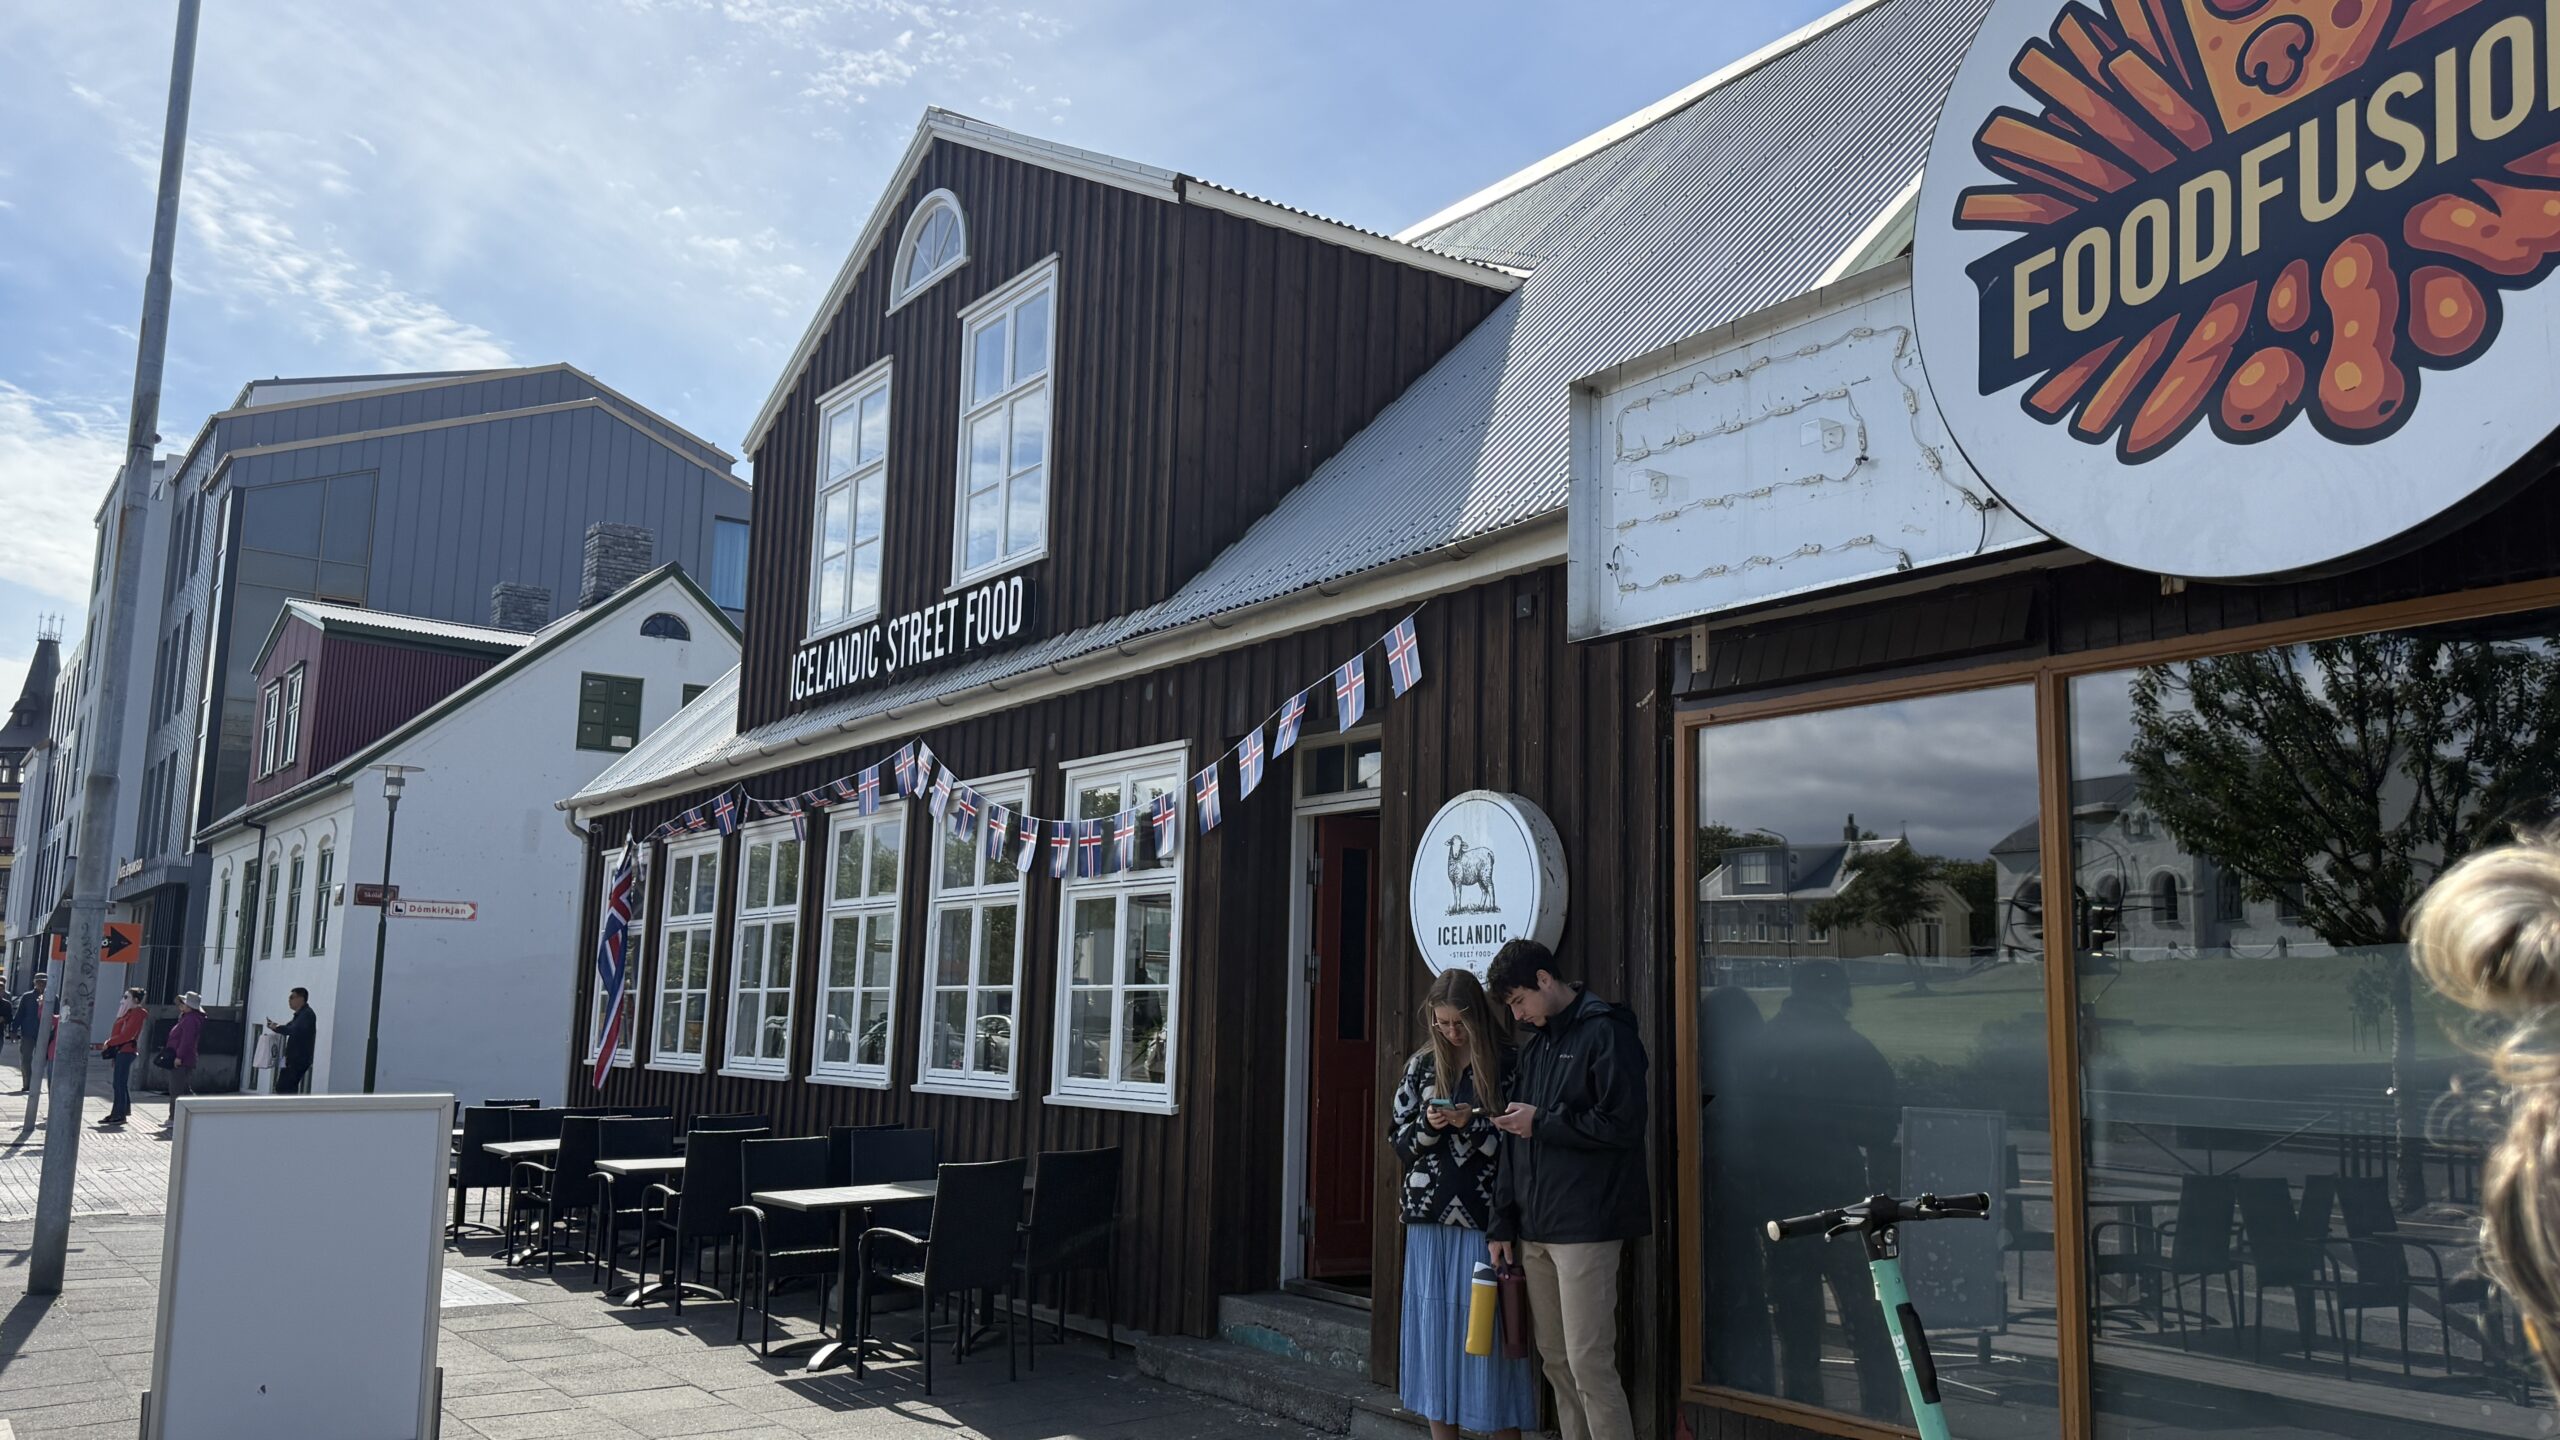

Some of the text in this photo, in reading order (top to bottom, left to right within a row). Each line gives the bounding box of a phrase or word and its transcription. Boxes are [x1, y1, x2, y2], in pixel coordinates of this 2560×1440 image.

[2013, 0, 2560, 360] FOODFUSIO
[790, 575, 1024, 702] ICELANDIC STREET FOOD
[409, 905, 467, 915] Dómkirkjan
[1438, 924, 1507, 946] ICELANDIC
[1453, 950, 1491, 959] STREET FOOD
[1891, 1334, 1912, 1373] Bolt
